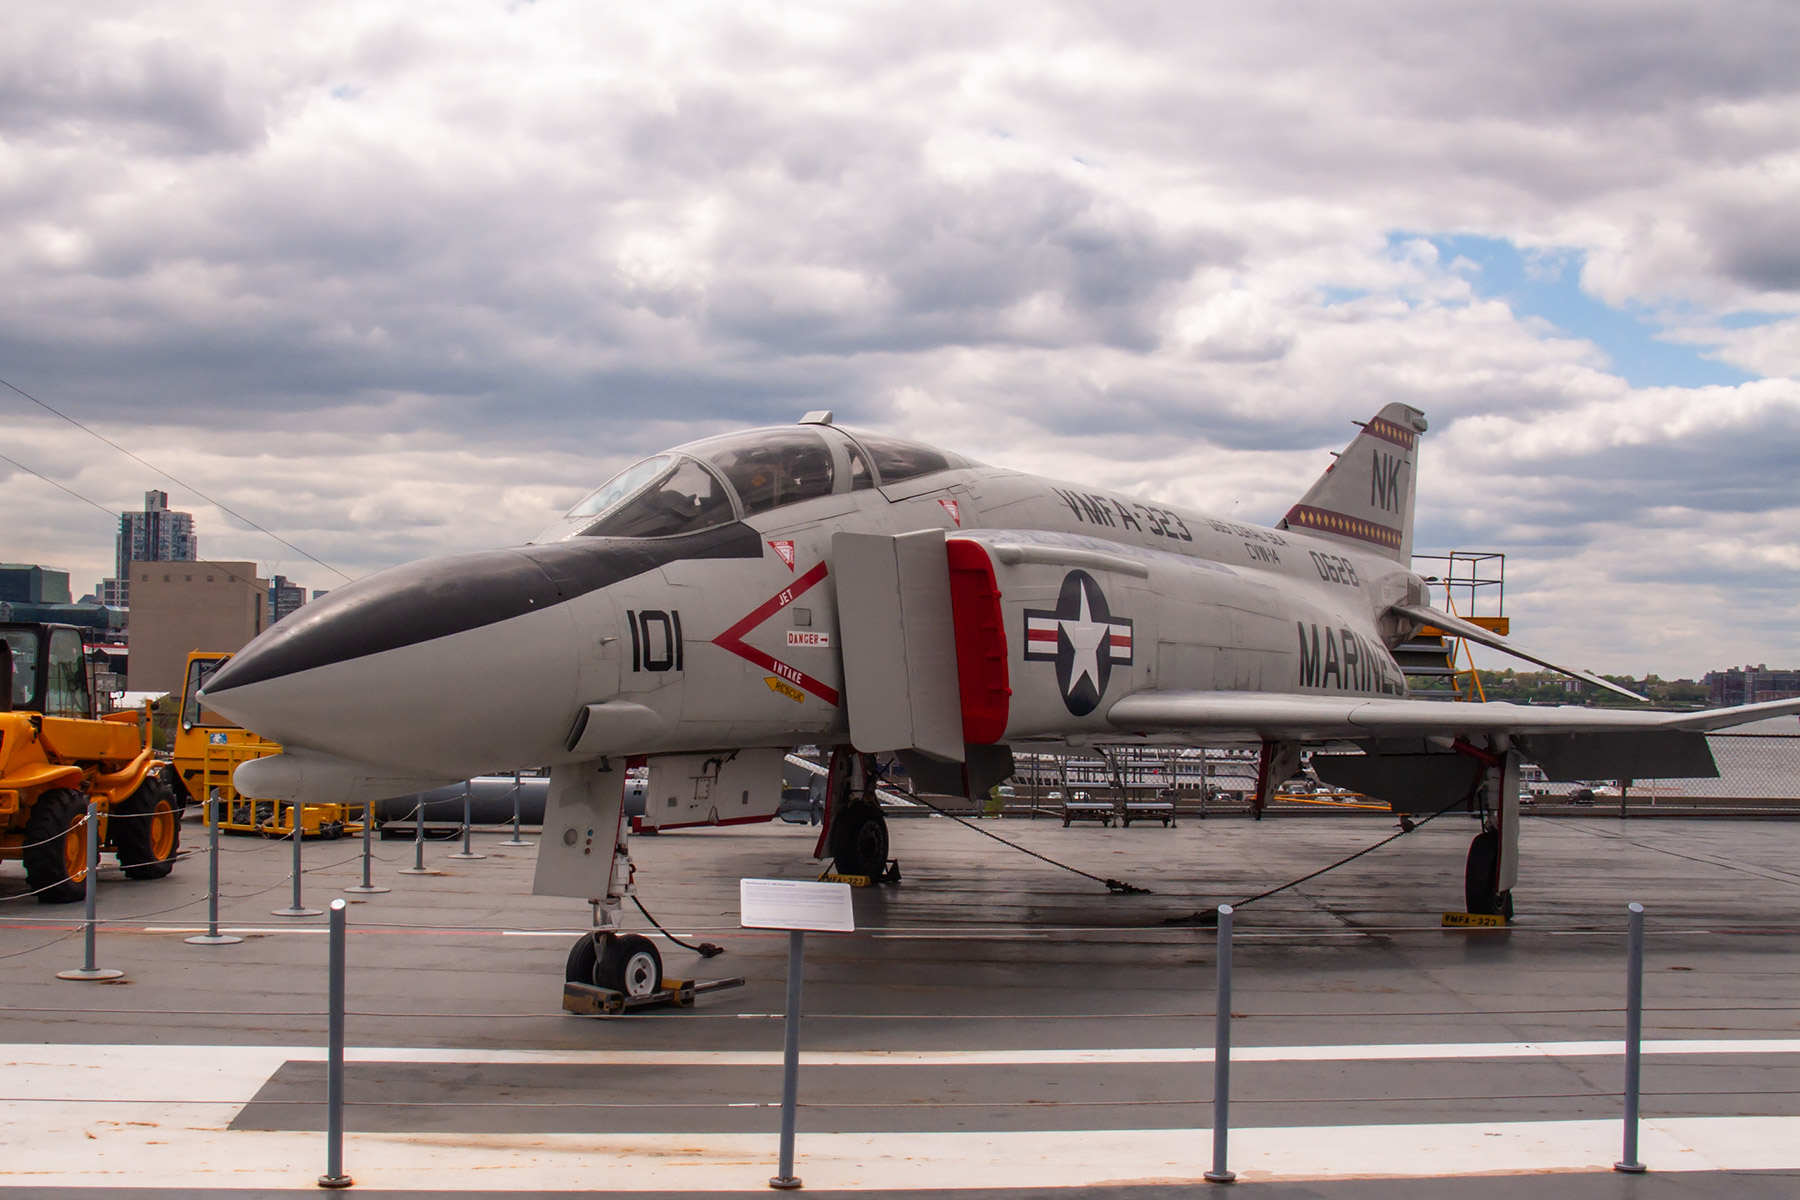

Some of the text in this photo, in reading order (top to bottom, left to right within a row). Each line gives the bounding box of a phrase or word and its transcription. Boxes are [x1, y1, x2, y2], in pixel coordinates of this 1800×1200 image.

[1371, 448, 1402, 515] NK
[1051, 487, 1193, 542] VMFA-323
[1308, 550, 1360, 587] 0628
[779, 589, 794, 606] JET
[626, 610, 683, 672] 101
[788, 633, 819, 645] DANGER
[773, 660, 803, 684] INTAKE
[1297, 621, 1406, 697] MARINES
[775, 682, 804, 702] RESCUE
[1445, 914, 1497, 926] VMFA-323
